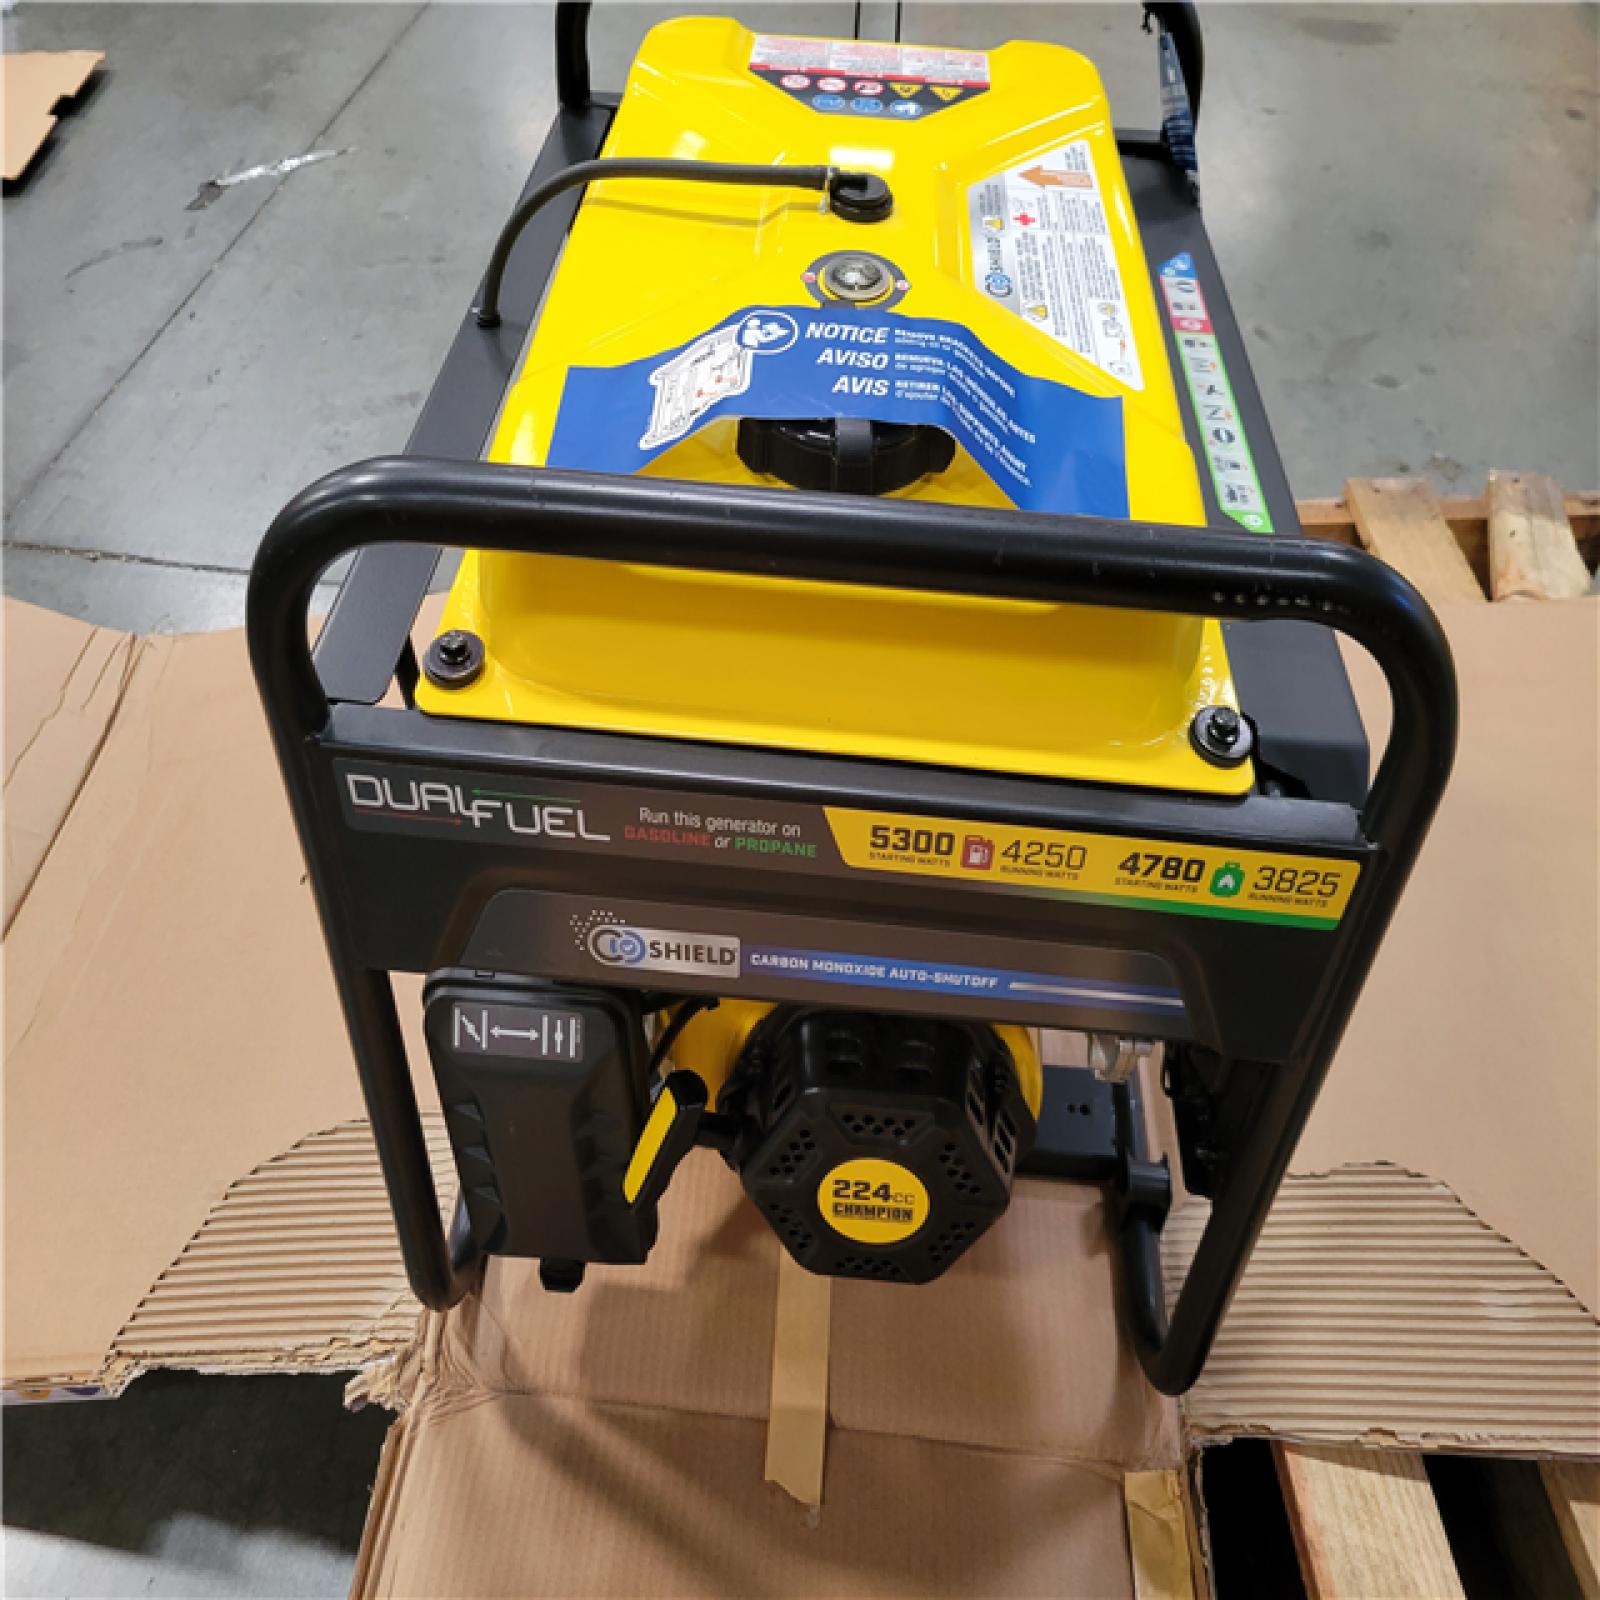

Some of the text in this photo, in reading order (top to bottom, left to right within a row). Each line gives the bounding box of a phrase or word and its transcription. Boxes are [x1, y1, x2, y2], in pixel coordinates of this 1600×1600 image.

[804, 322, 890, 343] NOTICE
[816, 347, 889, 370] AVISO
[831, 374, 890, 396] AVIS
[639, 806, 801, 838] Run this generator on
[624, 825, 817, 858] GASOLINE or PROPANE
[870, 824, 956, 856] 5300
[1001, 839, 1089, 871] 4250
[1117, 852, 1206, 883] 4780
[1254, 865, 1341, 897] 3825
[649, 939, 736, 966] SHIELD
[750, 953, 999, 989] CARBON MONOXIDE AUTO-SHUTOFF
[832, 1201, 914, 1223] CHAMPION
